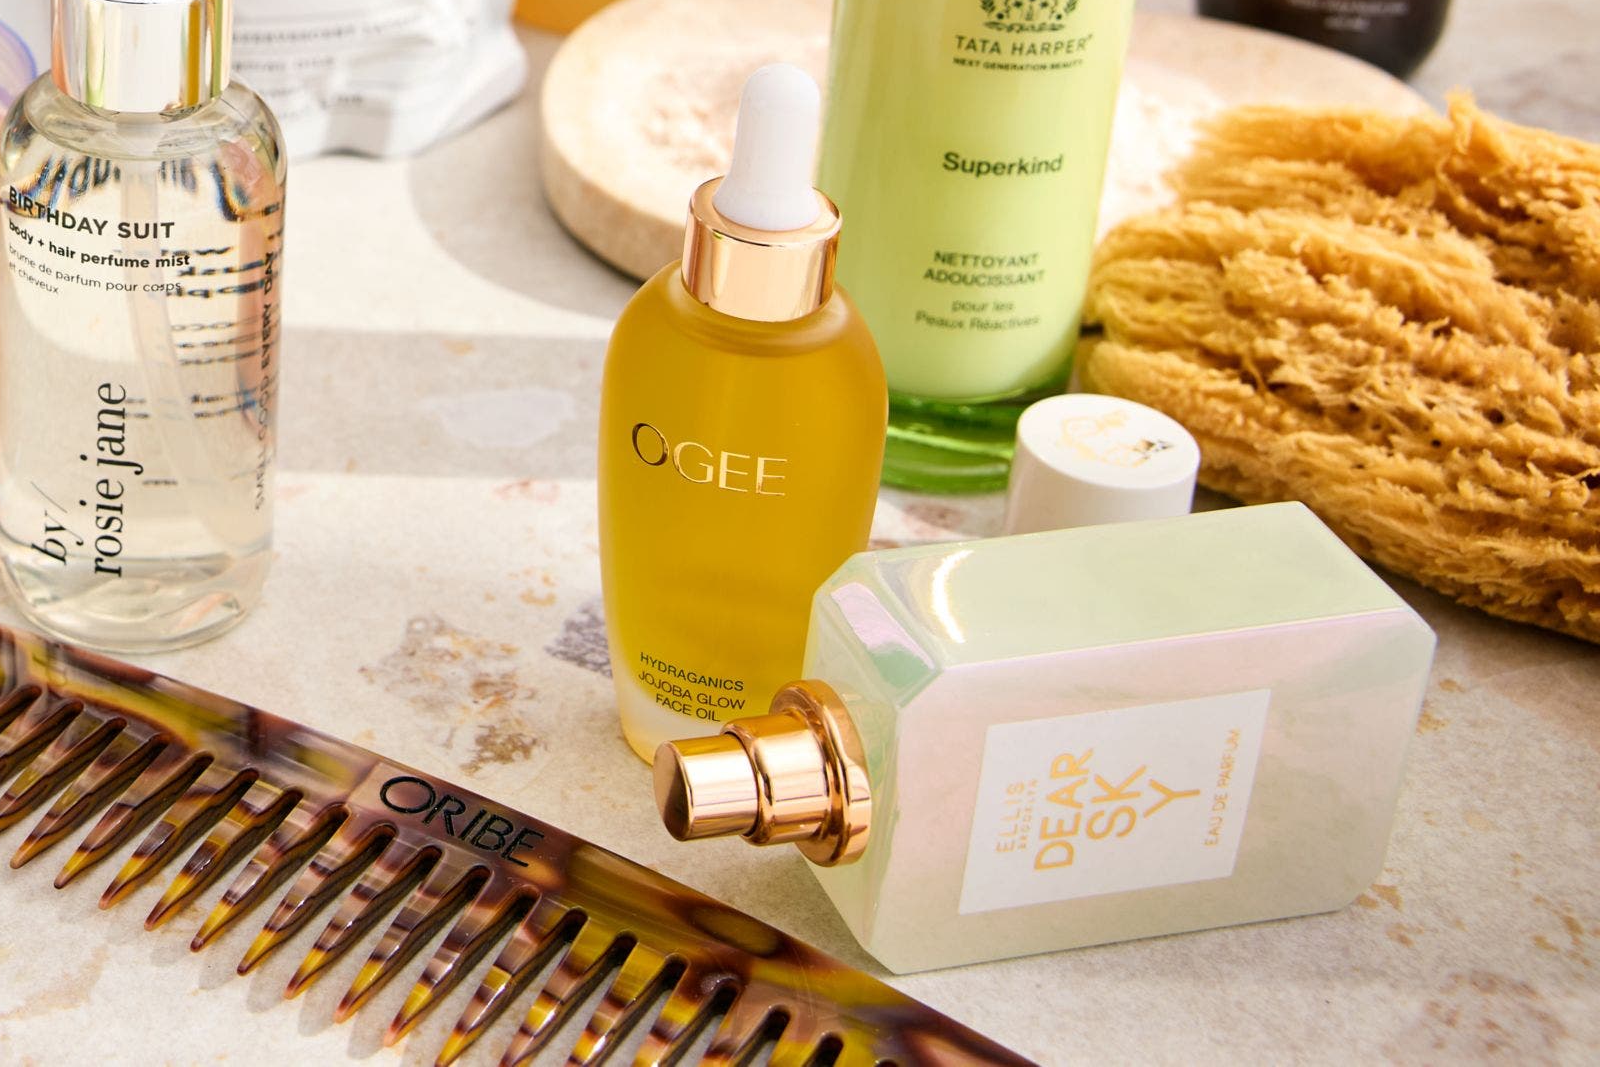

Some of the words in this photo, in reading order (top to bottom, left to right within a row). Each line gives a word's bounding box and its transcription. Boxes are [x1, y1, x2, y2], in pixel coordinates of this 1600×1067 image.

[953, 57, 980, 68] NEXT
[983, 61, 1047, 72] GENERATION
[1050, 59, 1083, 70] BEAUTY
[955, 35, 1002, 55] TATA
[1011, 38, 1088, 57] HARPER
[942, 151, 1064, 178] Superkind
[8, 185, 109, 236] BIRTHDAY
[117, 221, 176, 239] SUIT
[8, 217, 35, 246] body
[37, 239, 45, 247] +
[48, 241, 76, 260] hair
[80, 250, 150, 270] perfume
[155, 255, 191, 268] mist
[933, 250, 1040, 269] NETTOYANT
[8, 244, 37, 270] brume
[38, 261, 53, 276] de
[55, 269, 101, 290] parfum
[105, 282, 139, 296] pour
[18, 267, 60, 295] cheveux
[923, 267, 1046, 288] ADOUCISSANT
[915, 309, 964, 330] Peaux
[951, 300, 988, 313] pour
[79, 382, 144, 476] jane
[631, 422, 788, 497] OGEE
[78, 478, 125, 578] rosie
[638, 670, 693, 702] JOJOBA
[696, 693, 746, 710] GLOW
[639, 651, 745, 692] HYDRAGANICS
[655, 693, 693, 716] FACE
[695, 707, 721, 723] OIL
[1216, 728, 1242, 788] PARFUM
[379, 775, 545, 868] ORIBE
[995, 781, 1025, 853] ELLIS
[1032, 746, 1095, 872] DEAR
[1210, 791, 1229, 814] DE
[1203, 814, 1223, 847] EAU
